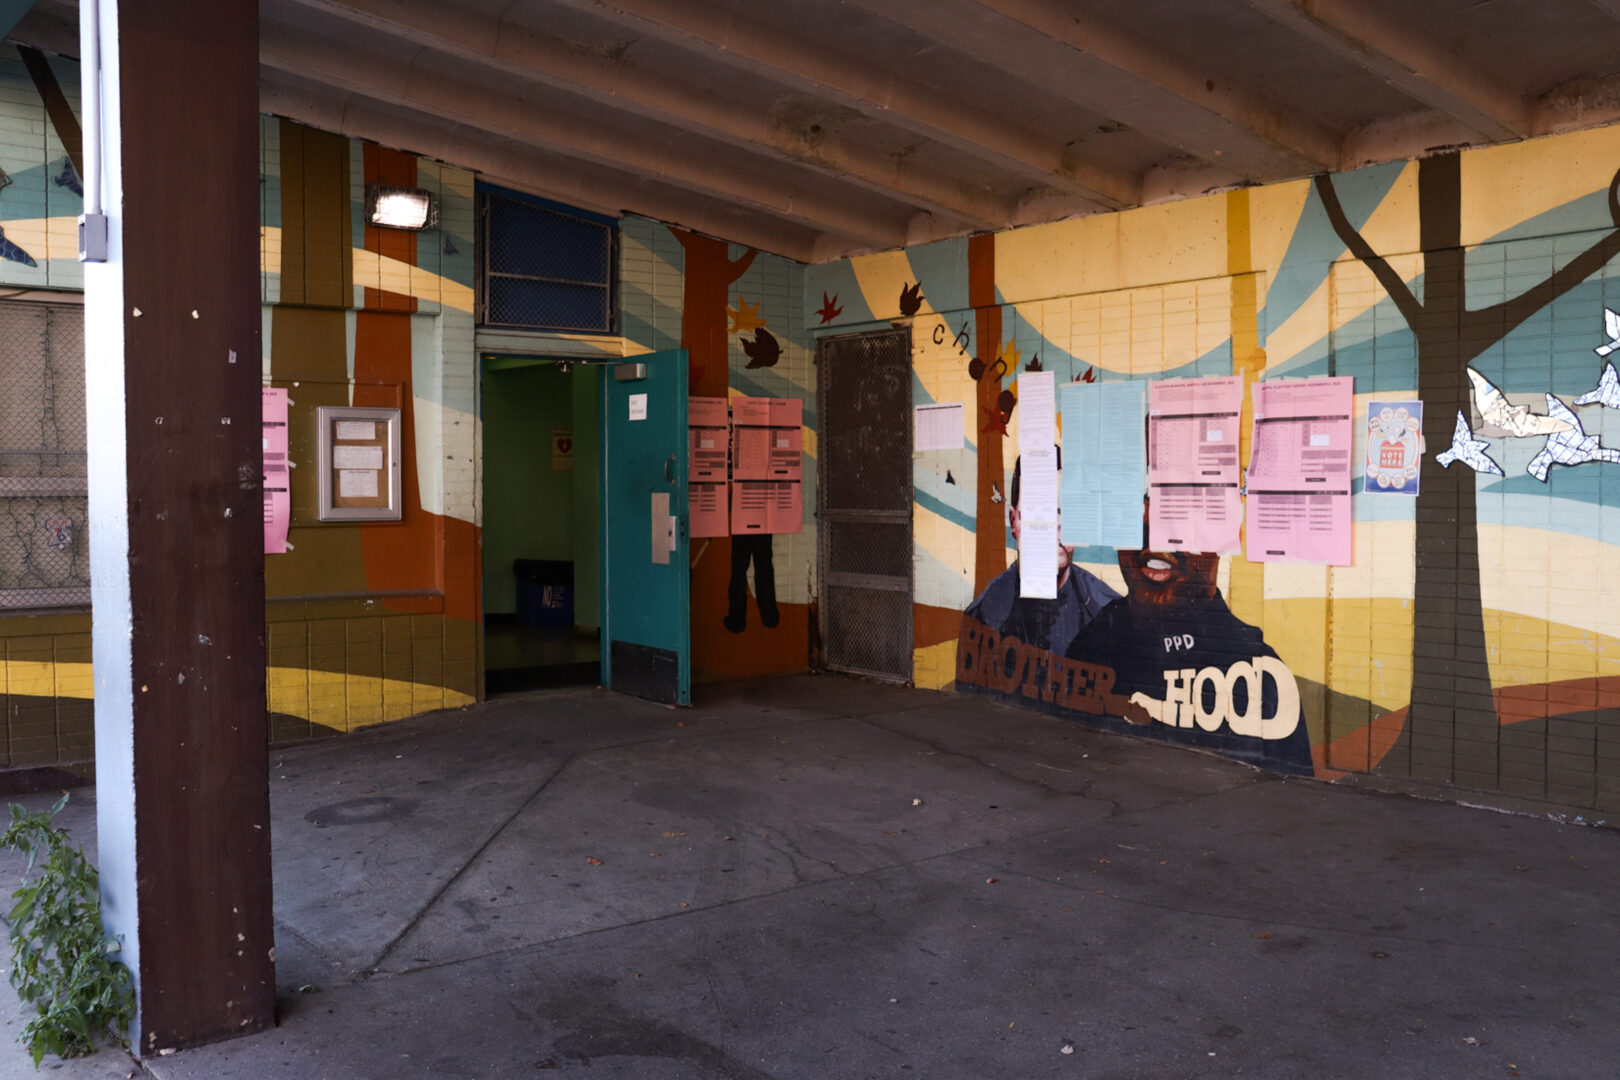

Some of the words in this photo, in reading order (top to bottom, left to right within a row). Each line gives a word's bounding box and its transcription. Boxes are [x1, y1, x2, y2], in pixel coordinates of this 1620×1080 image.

[955, 614, 1130, 716] BROTHER
[1163, 655, 1301, 740] HOOD
[1163, 634, 1195, 653] PPD
